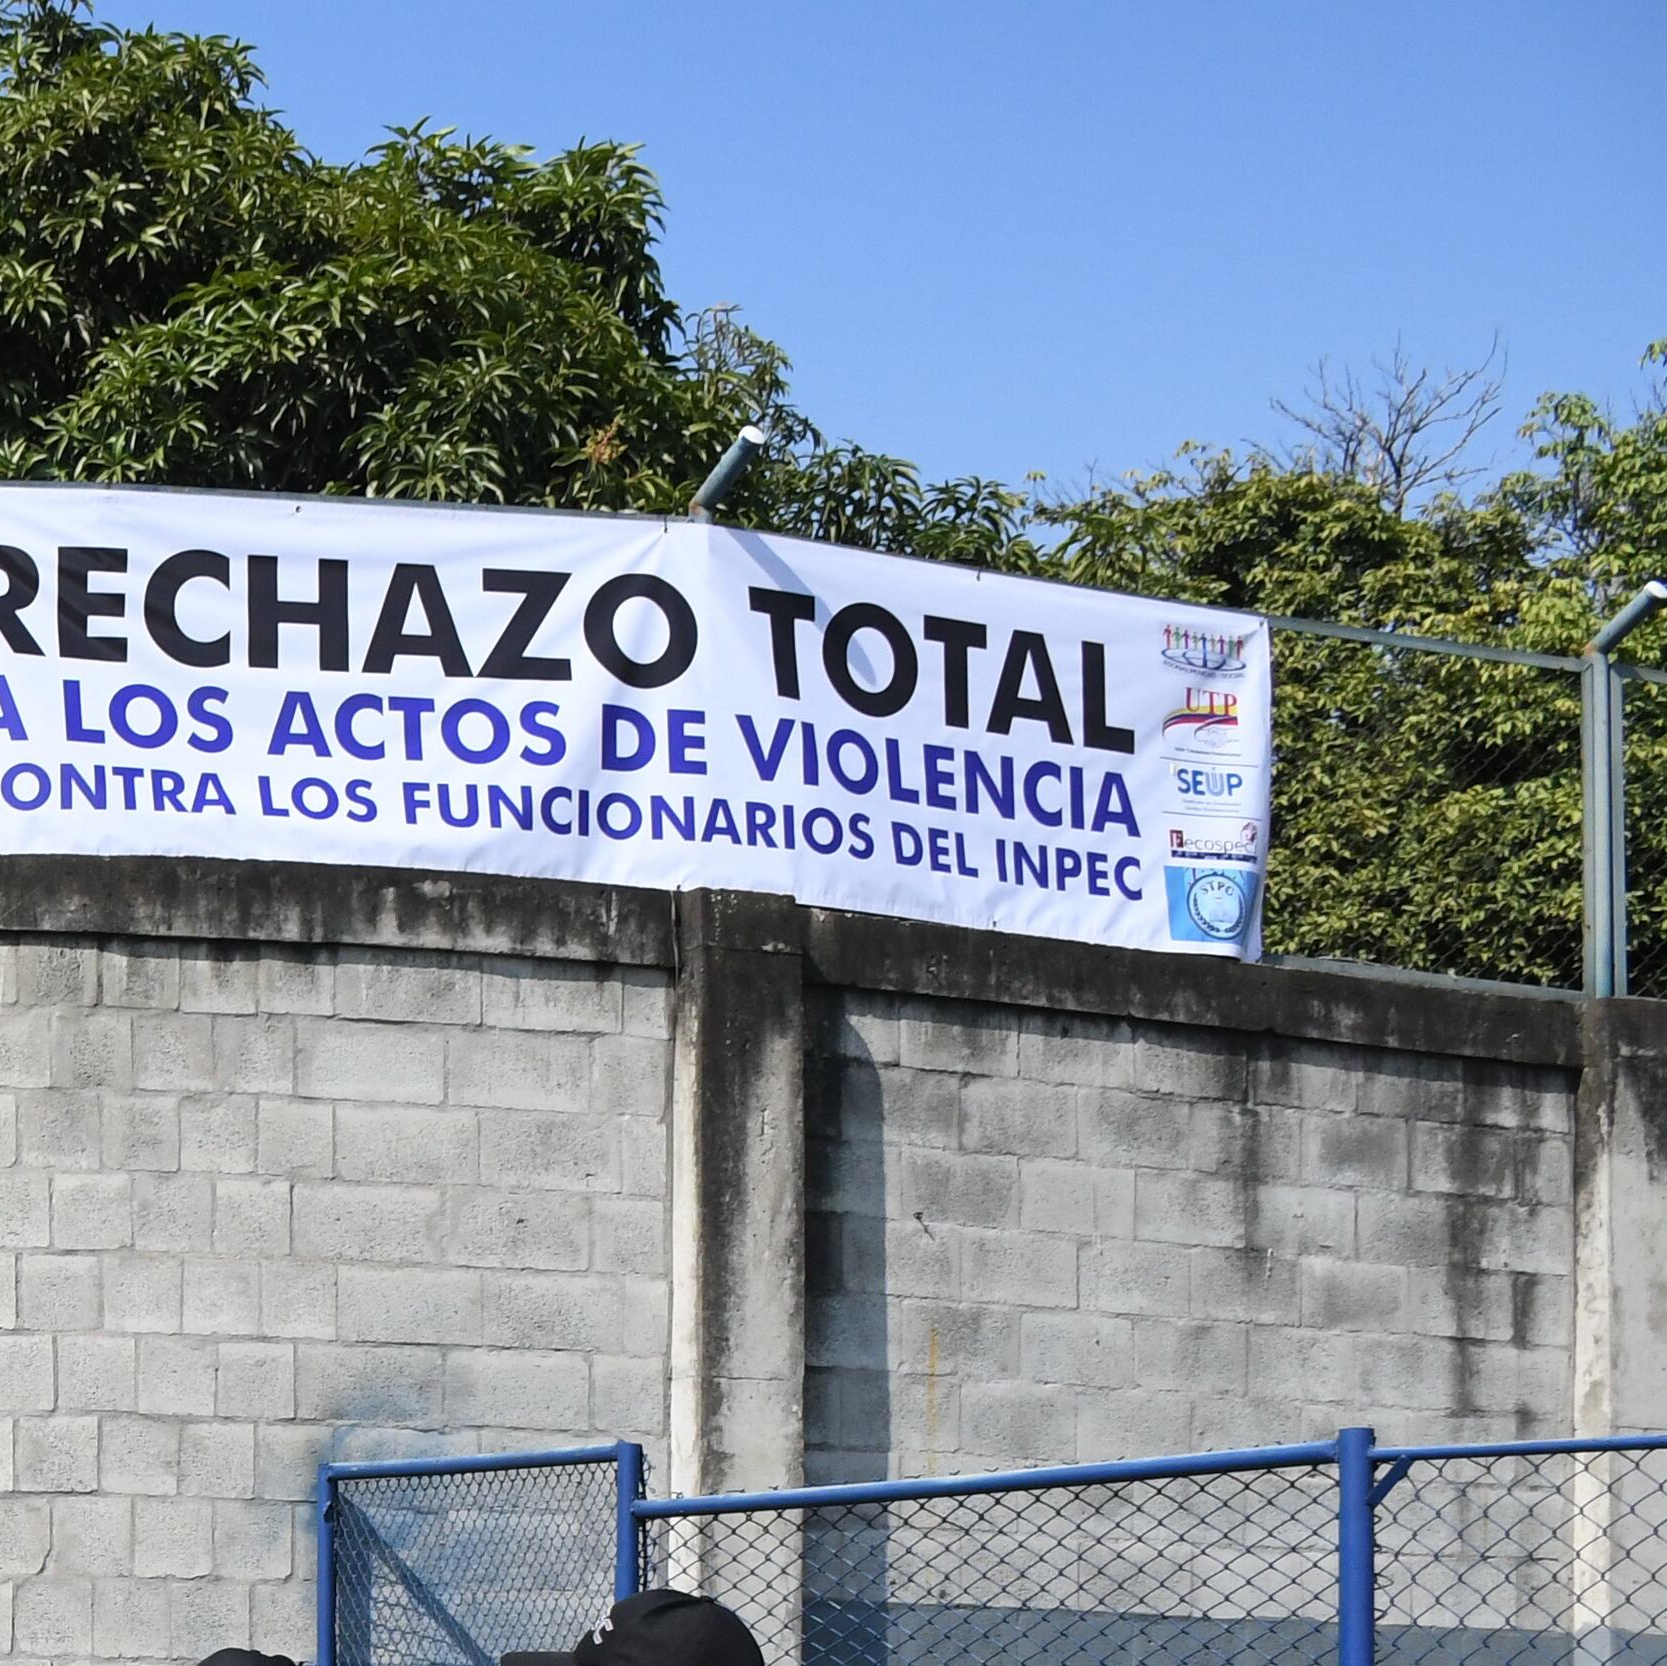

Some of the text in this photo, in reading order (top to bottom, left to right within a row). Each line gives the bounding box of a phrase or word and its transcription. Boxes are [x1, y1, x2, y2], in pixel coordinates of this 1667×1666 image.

[748, 585, 1135, 755] TOTAL
[1185, 686, 1238, 717] UTP
[62, 678, 234, 753] LOS
[266, 690, 567, 766] ACTOS
[601, 703, 707, 776] DE
[734, 714, 1141, 838] VIOLENCIA
[1176, 766, 1243, 797] SEUP
[257, 775, 378, 823] LOS
[400, 780, 875, 861] FUNCIONARIOS
[890, 821, 979, 879] DEL
[995, 838, 1143, 901] INPEC
[1199, 880, 1235, 897] STPC
